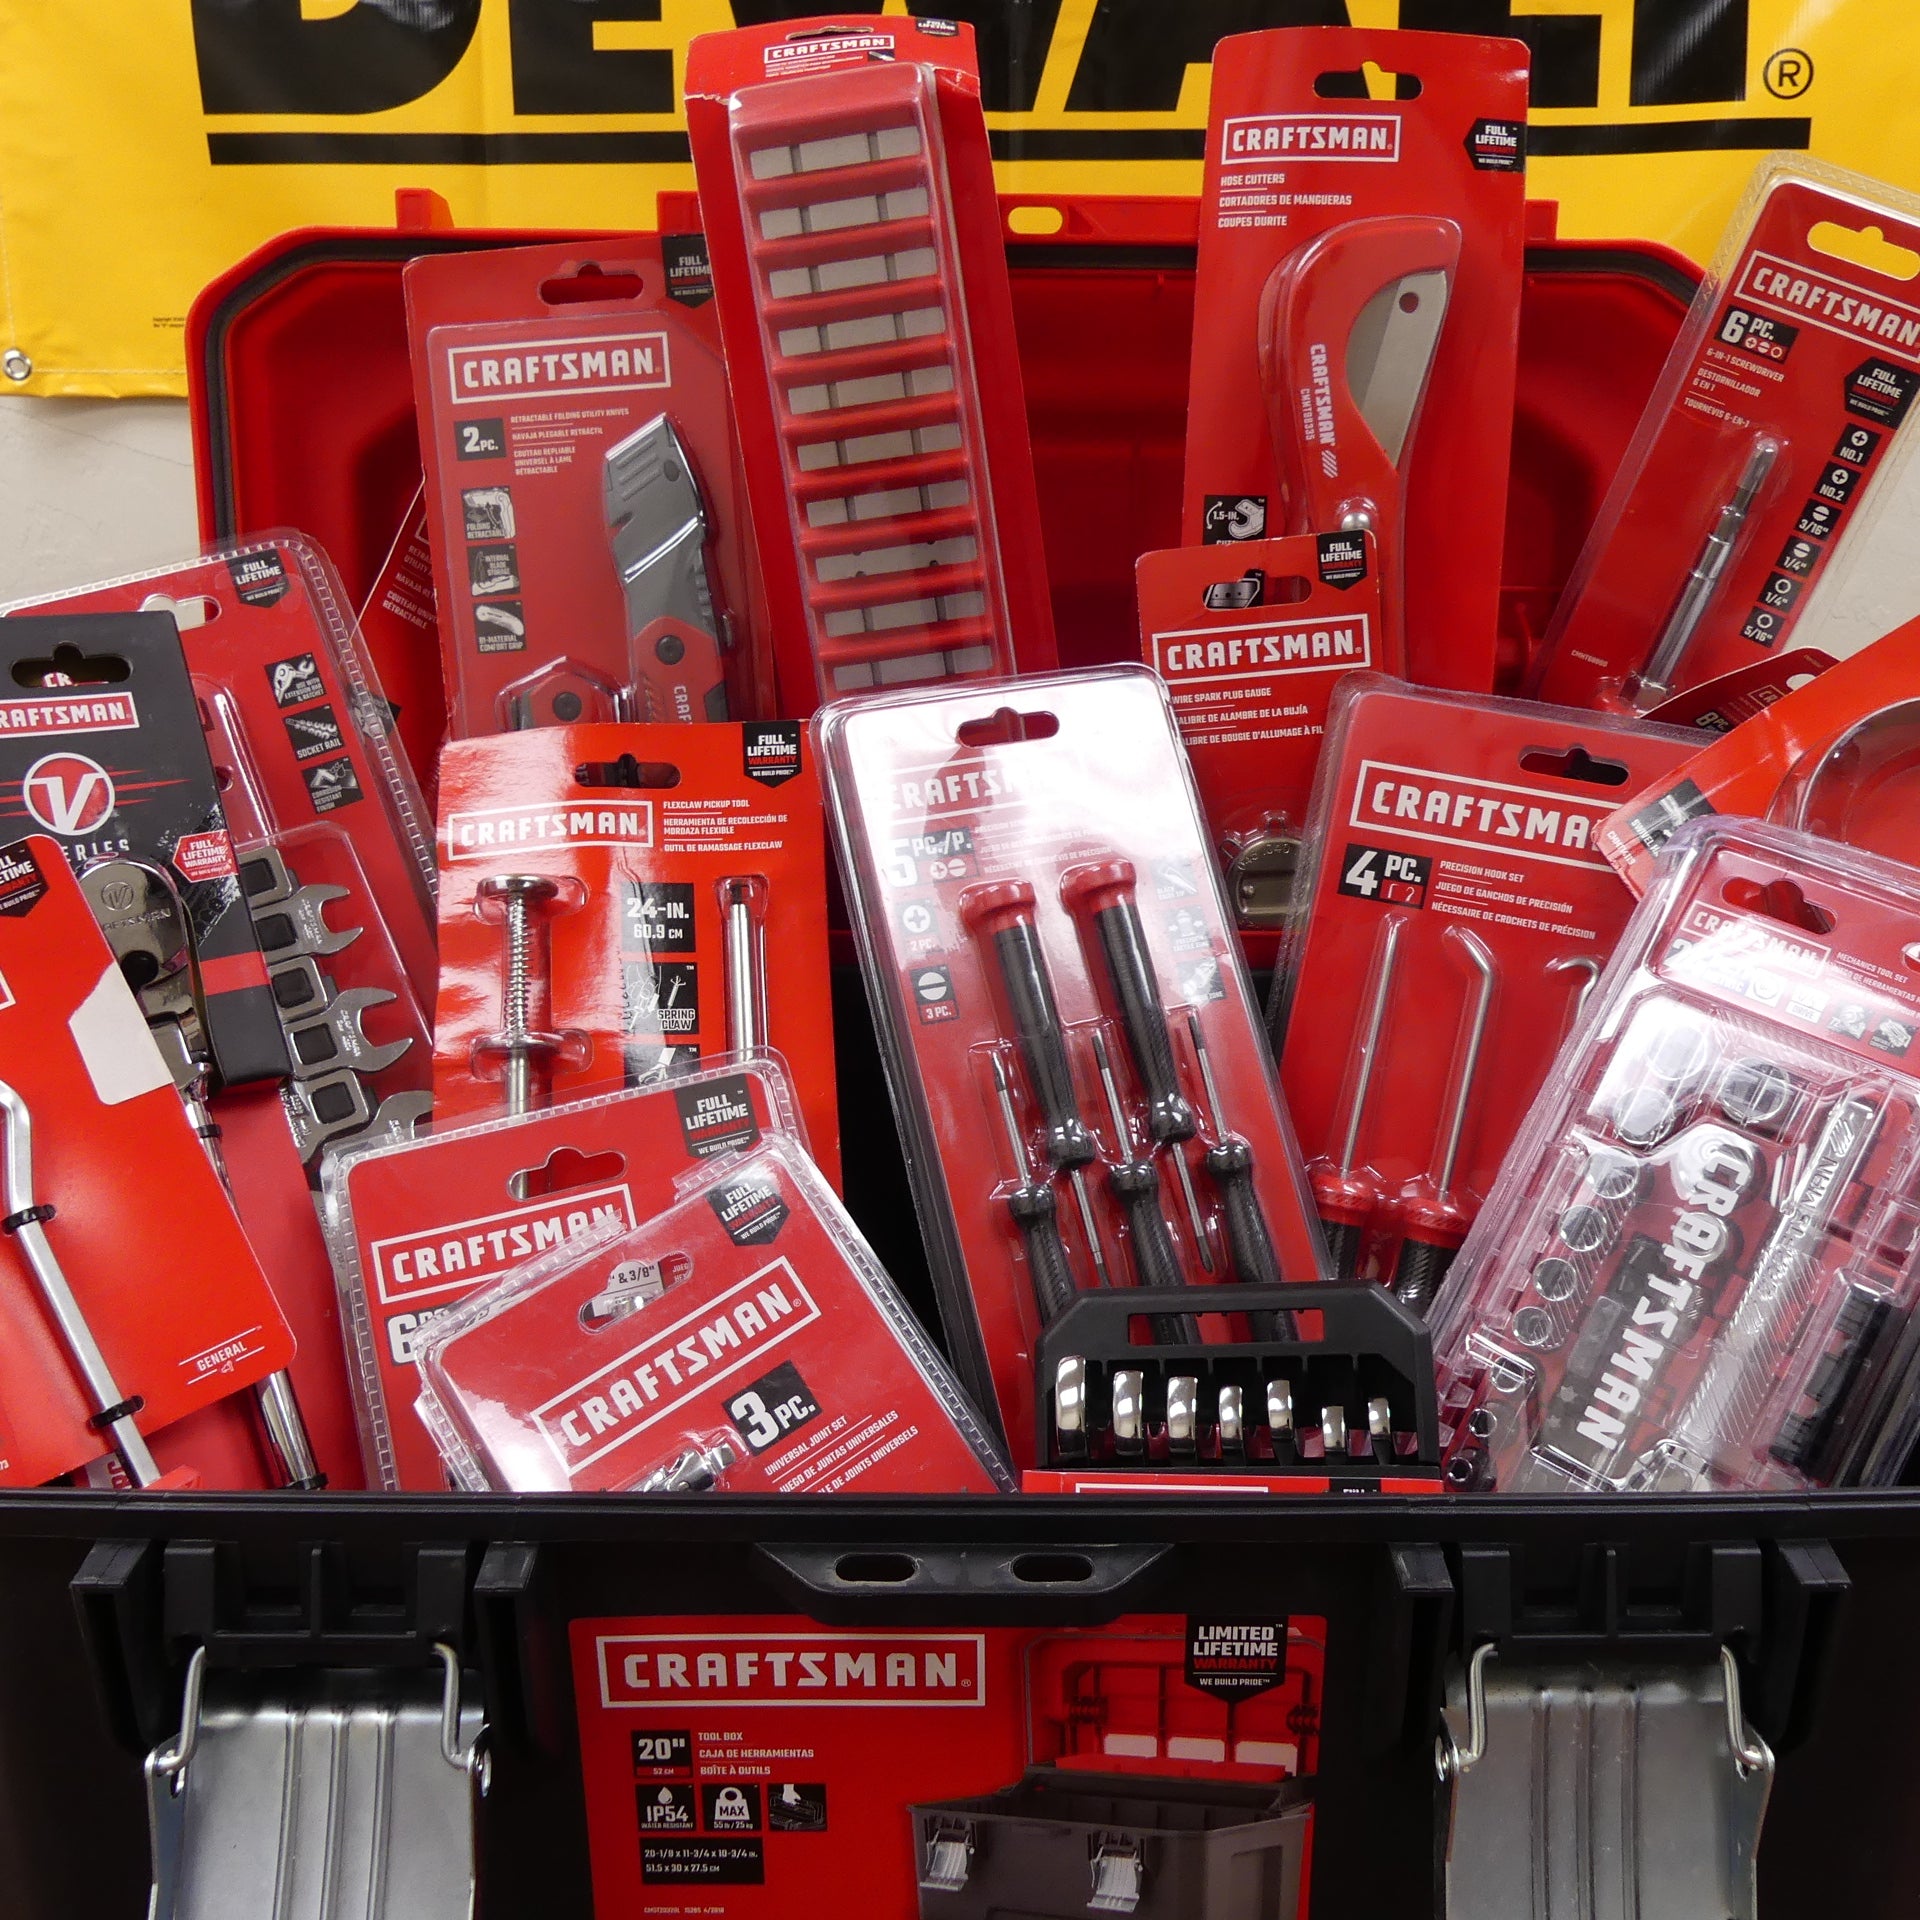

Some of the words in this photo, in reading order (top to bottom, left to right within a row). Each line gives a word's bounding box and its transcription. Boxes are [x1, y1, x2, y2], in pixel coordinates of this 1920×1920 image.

[1485, 125, 1508, 136] FULL
[1233, 127, 1387, 152] CRAFTSMAN
[1475, 134, 1517, 147] LIFETIME
[1221, 175, 1243, 186] HOSE
[1245, 173, 1285, 185] CUTTERS
[1219, 194, 1277, 207] CORTADORES
[1279, 194, 1292, 206] DE
[1294, 194, 1352, 206] MANGUERAS
[1218, 216, 1252, 228] COUPES
[1254, 215, 1287, 227] DURITE
[679, 256, 702, 266] FULL
[1721, 311, 1749, 344] 6
[463, 348, 653, 388] CRAFTSMAN
[1706, 348, 1730, 364] 6-IN-1
[1730, 356, 1785, 383] SCREWDRIVER
[1697, 367, 1761, 398] DESTORNILLADOR
[1872, 368, 1897, 386] FULL
[1857, 374, 1903, 399] LIFETIME
[1684, 397, 1725, 418] TOURNEVIS
[511, 413, 553, 424] RETRACTABLE
[554, 411, 581, 421] FOLDING
[581, 409, 605, 418] UTILITY
[606, 408, 630, 417] KNIVES
[512, 431, 537, 440] NAVAJA
[538, 429, 568, 439] PLEGABLE
[514, 448, 542, 458] COUTEAU
[1839, 446, 1864, 464] NO.1
[515, 456, 548, 467] UNIVERSEL
[1820, 484, 1846, 502] NO.2
[1213, 510, 1240, 520] 1.5-IN.
[1329, 542, 1352, 552] FULL
[1320, 550, 1362, 563] LIFETIME
[242, 560, 268, 574] FULL
[236, 566, 282, 586] LIFETIME
[479, 634, 517, 644] BI-MATERIAL
[480, 642, 503, 652] COMFORT
[1167, 629, 1354, 671] CRAFTSMAN
[1172, 694, 1194, 704] WIRE
[1194, 692, 1222, 702] SPARK
[1222, 690, 1243, 700] PLUG
[1245, 688, 1272, 698] GAUGE
[1208, 713, 1218, 722] DE
[1220, 710, 1258, 722] ALAMBRE
[1260, 708, 1270, 718] DE
[1272, 707, 1282, 718] LA
[758, 734, 786, 745] FULL
[1210, 734, 1220, 744] DE
[1222, 732, 1251, 743] BOUGIE
[1252, 728, 1302, 741] D'ALLUMAGE
[1312, 725, 1324, 735] FIL
[297, 744, 323, 758] SOCKET
[324, 740, 342, 753] RAIL
[747, 744, 796, 756] LIFETIME
[748, 755, 796, 765] WARRANTY
[664, 800, 702, 810] FLEXCLAW
[704, 800, 730, 809] PICKUP
[731, 800, 750, 808] TOOL
[664, 818, 716, 828] HERRAMIENTA
[717, 817, 726, 826] DE
[728, 814, 776, 825] RECOLECCIÓN
[778, 814, 788, 824] DE
[1372, 780, 1600, 851] CRAFTSMA
[460, 811, 638, 847] CRAFTSMAN
[664, 826, 700, 836] MORDAZA
[701, 826, 734, 836] FLEXIBLE
[190, 841, 214, 850] FULL
[664, 844, 684, 853] OUTIL
[686, 843, 696, 852] DE
[698, 842, 742, 852] RAMASSAGE
[744, 840, 782, 851] FLEXCLAW
[182, 847, 226, 860] LIFETIME
[185, 854, 226, 868] WARRANTY
[1344, 850, 1378, 896] 4
[1384, 854, 1422, 882] PC.
[1440, 860, 1484, 876] PRECISION
[1484, 866, 1508, 880] HOOK
[1508, 871, 1525, 884] SET
[1435, 880, 1462, 894] JUEGO
[1463, 884, 1475, 896] DE
[1476, 886, 1515, 904] GANCHOS
[1516, 894, 1528, 906] DE
[1528, 894, 1574, 914] PRECISIÓN
[627, 898, 690, 920] 24-IN.
[1432, 899, 1481, 920] NÉCESSAIRE
[1482, 908, 1494, 920] DE
[1494, 910, 1538, 929] CROCHETS
[1538, 919, 1550, 932] DE
[1551, 921, 1596, 940] PRÉCISION
[634, 923, 664, 940] 60.9
[668, 928, 683, 940] CM
[1836, 952, 1877, 973] MECHANICS
[1876, 966, 1894, 980] TOOL
[1894, 974, 1908, 984] SET
[658, 1008, 696, 1022] SPRING
[934, 1006, 952, 1018] PC.
[662, 1018, 692, 1030] CLAW
[697, 1094, 732, 1113] FULL
[686, 1104, 748, 1130] LIFETIME
[692, 1118, 752, 1140] WARRANTY
[726, 1182, 752, 1203] FULL
[720, 1184, 772, 1222] LIFETIME
[726, 1200, 777, 1230] WARRANTY
[630, 1265, 655, 1281] 3/8"
[197, 1341, 248, 1372] GENERAL
[764, 1442, 810, 1476] UNIVERSAL
[809, 1427, 833, 1448] JOINT
[832, 1416, 848, 1432] SET
[804, 1466, 817, 1480] DE
[816, 1446, 846, 1471] JUNTAS
[846, 1410, 899, 1450] UNIVERSALES
[832, 1479, 844, 1492] DE
[844, 1458, 873, 1482] JOINTS
[872, 1425, 920, 1463] UNIVERSELS
[1198, 1626, 1274, 1641] LIMITED
[1193, 1642, 1278, 1657] LIFETIME
[624, 1652, 958, 1688] CRAFTSMAN
[1193, 1658, 1278, 1670] WARRANTY
[1200, 1678, 1212, 1686] WE
[1214, 1678, 1238, 1686] BUILD
[698, 1732, 722, 1741] TOOL
[724, 1732, 744, 1741] BOX
[638, 1738, 686, 1760] 20"
[699, 1749, 724, 1758] CAJA
[726, 1749, 738, 1758] DE
[740, 1749, 814, 1758] HERRAMIENTAS
[700, 1764, 727, 1776] BOÎTE
[738, 1766, 771, 1776] OUTILS
[646, 1805, 688, 1822] IP54
[719, 1806, 745, 1816] MAX
[683, 1849, 710, 1858] 11-3/4
[718, 1849, 748, 1858] 10-3/4
[690, 1864, 708, 1872] 27.5
